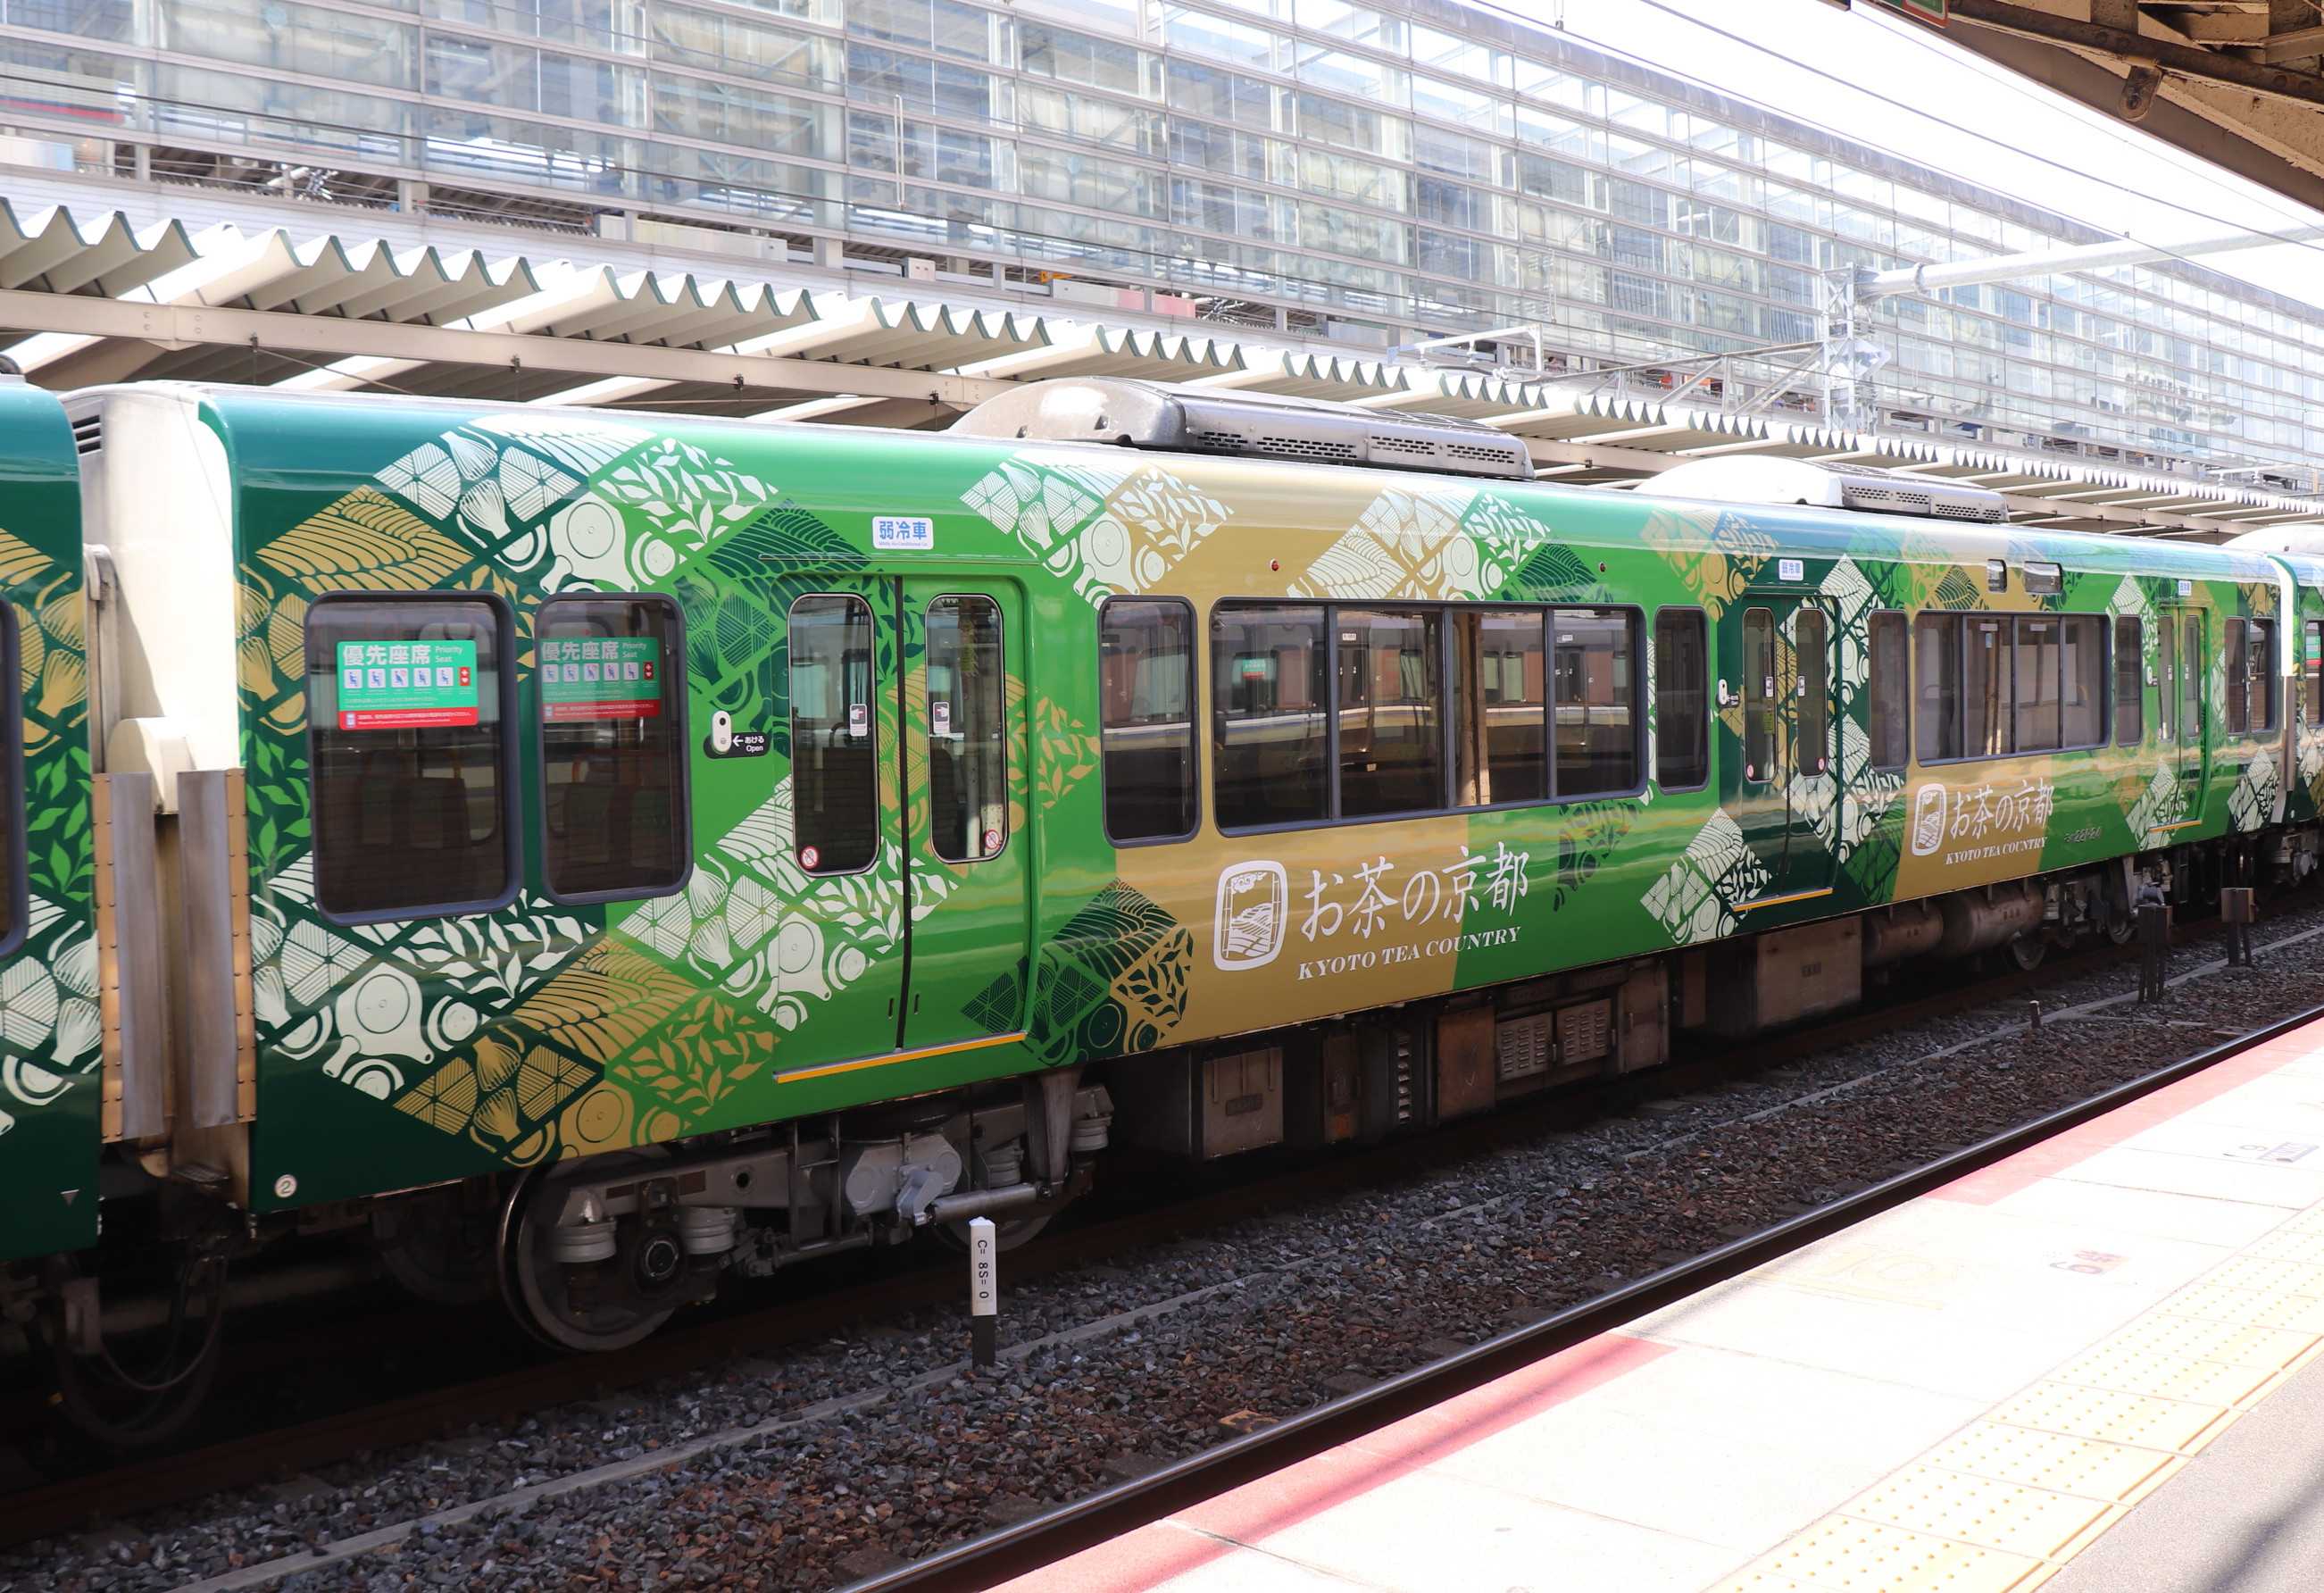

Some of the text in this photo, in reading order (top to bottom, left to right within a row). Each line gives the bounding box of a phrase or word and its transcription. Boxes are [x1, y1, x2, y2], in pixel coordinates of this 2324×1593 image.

[879, 521, 928, 540] 弱冷車
[343, 644, 431, 666] 優先座席
[436, 645, 462, 655] Priority
[436, 655, 453, 663] Seat
[542, 641, 619, 661] 優先座席
[746, 745, 763, 753] Open
[1950, 777, 2054, 840] お茶の京都
[1945, 836, 2048, 864] KYOTO TEA COUNTRY
[1300, 841, 1529, 942] お茶の京都
[1296, 926, 1522, 980] KYOTO TEA COUNTRY
